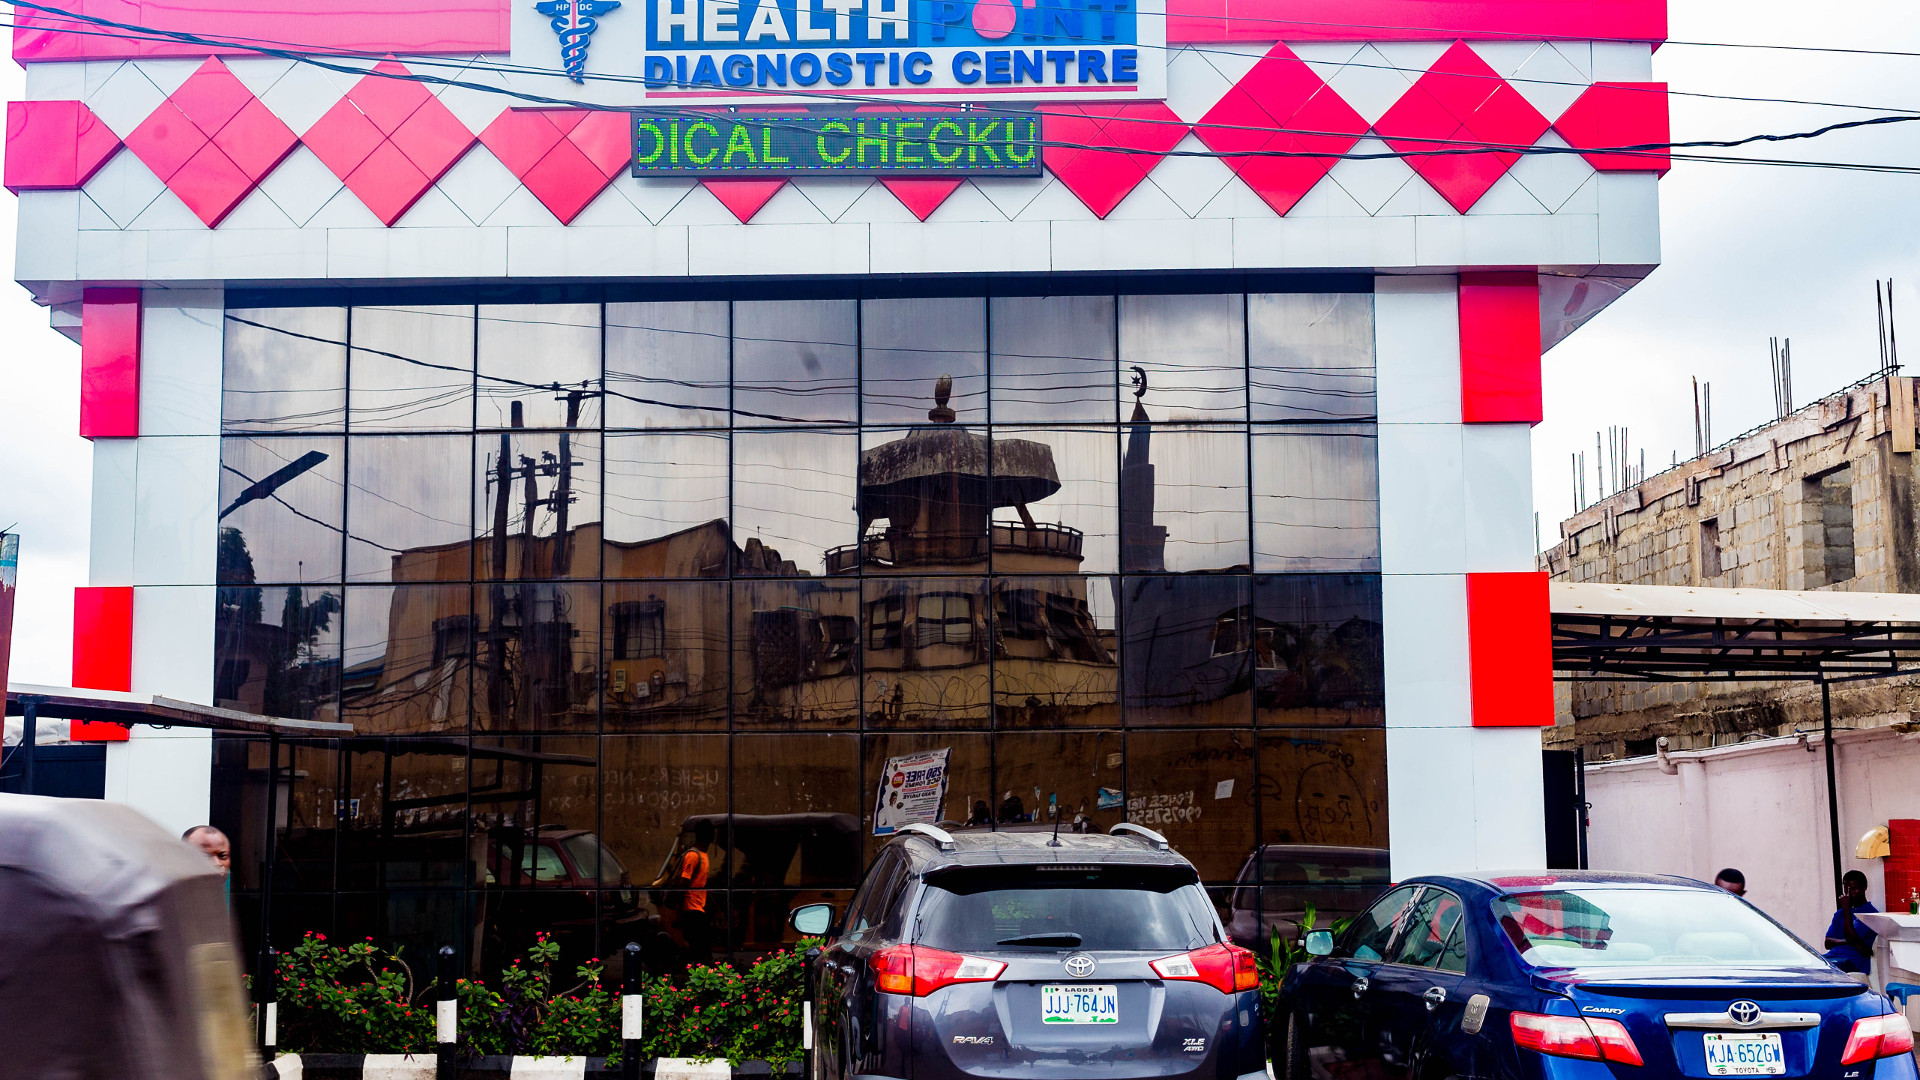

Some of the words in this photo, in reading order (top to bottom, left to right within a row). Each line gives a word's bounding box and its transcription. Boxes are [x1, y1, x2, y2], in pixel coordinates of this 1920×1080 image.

[555, 3, 570, 11] HP
[579, 3, 593, 11] DC
[657, 0, 909, 42] HEALTH
[931, 0, 1129, 40] POINT
[645, 50, 933, 89] DIAGNOSTIC
[951, 48, 1138, 87] CENTRE
[639, 121, 789, 164] DICAL
[816, 121, 1036, 163] CHECKU
[952, 1035, 994, 1045] RAV4
[1182, 1037, 1206, 1045] XLE
